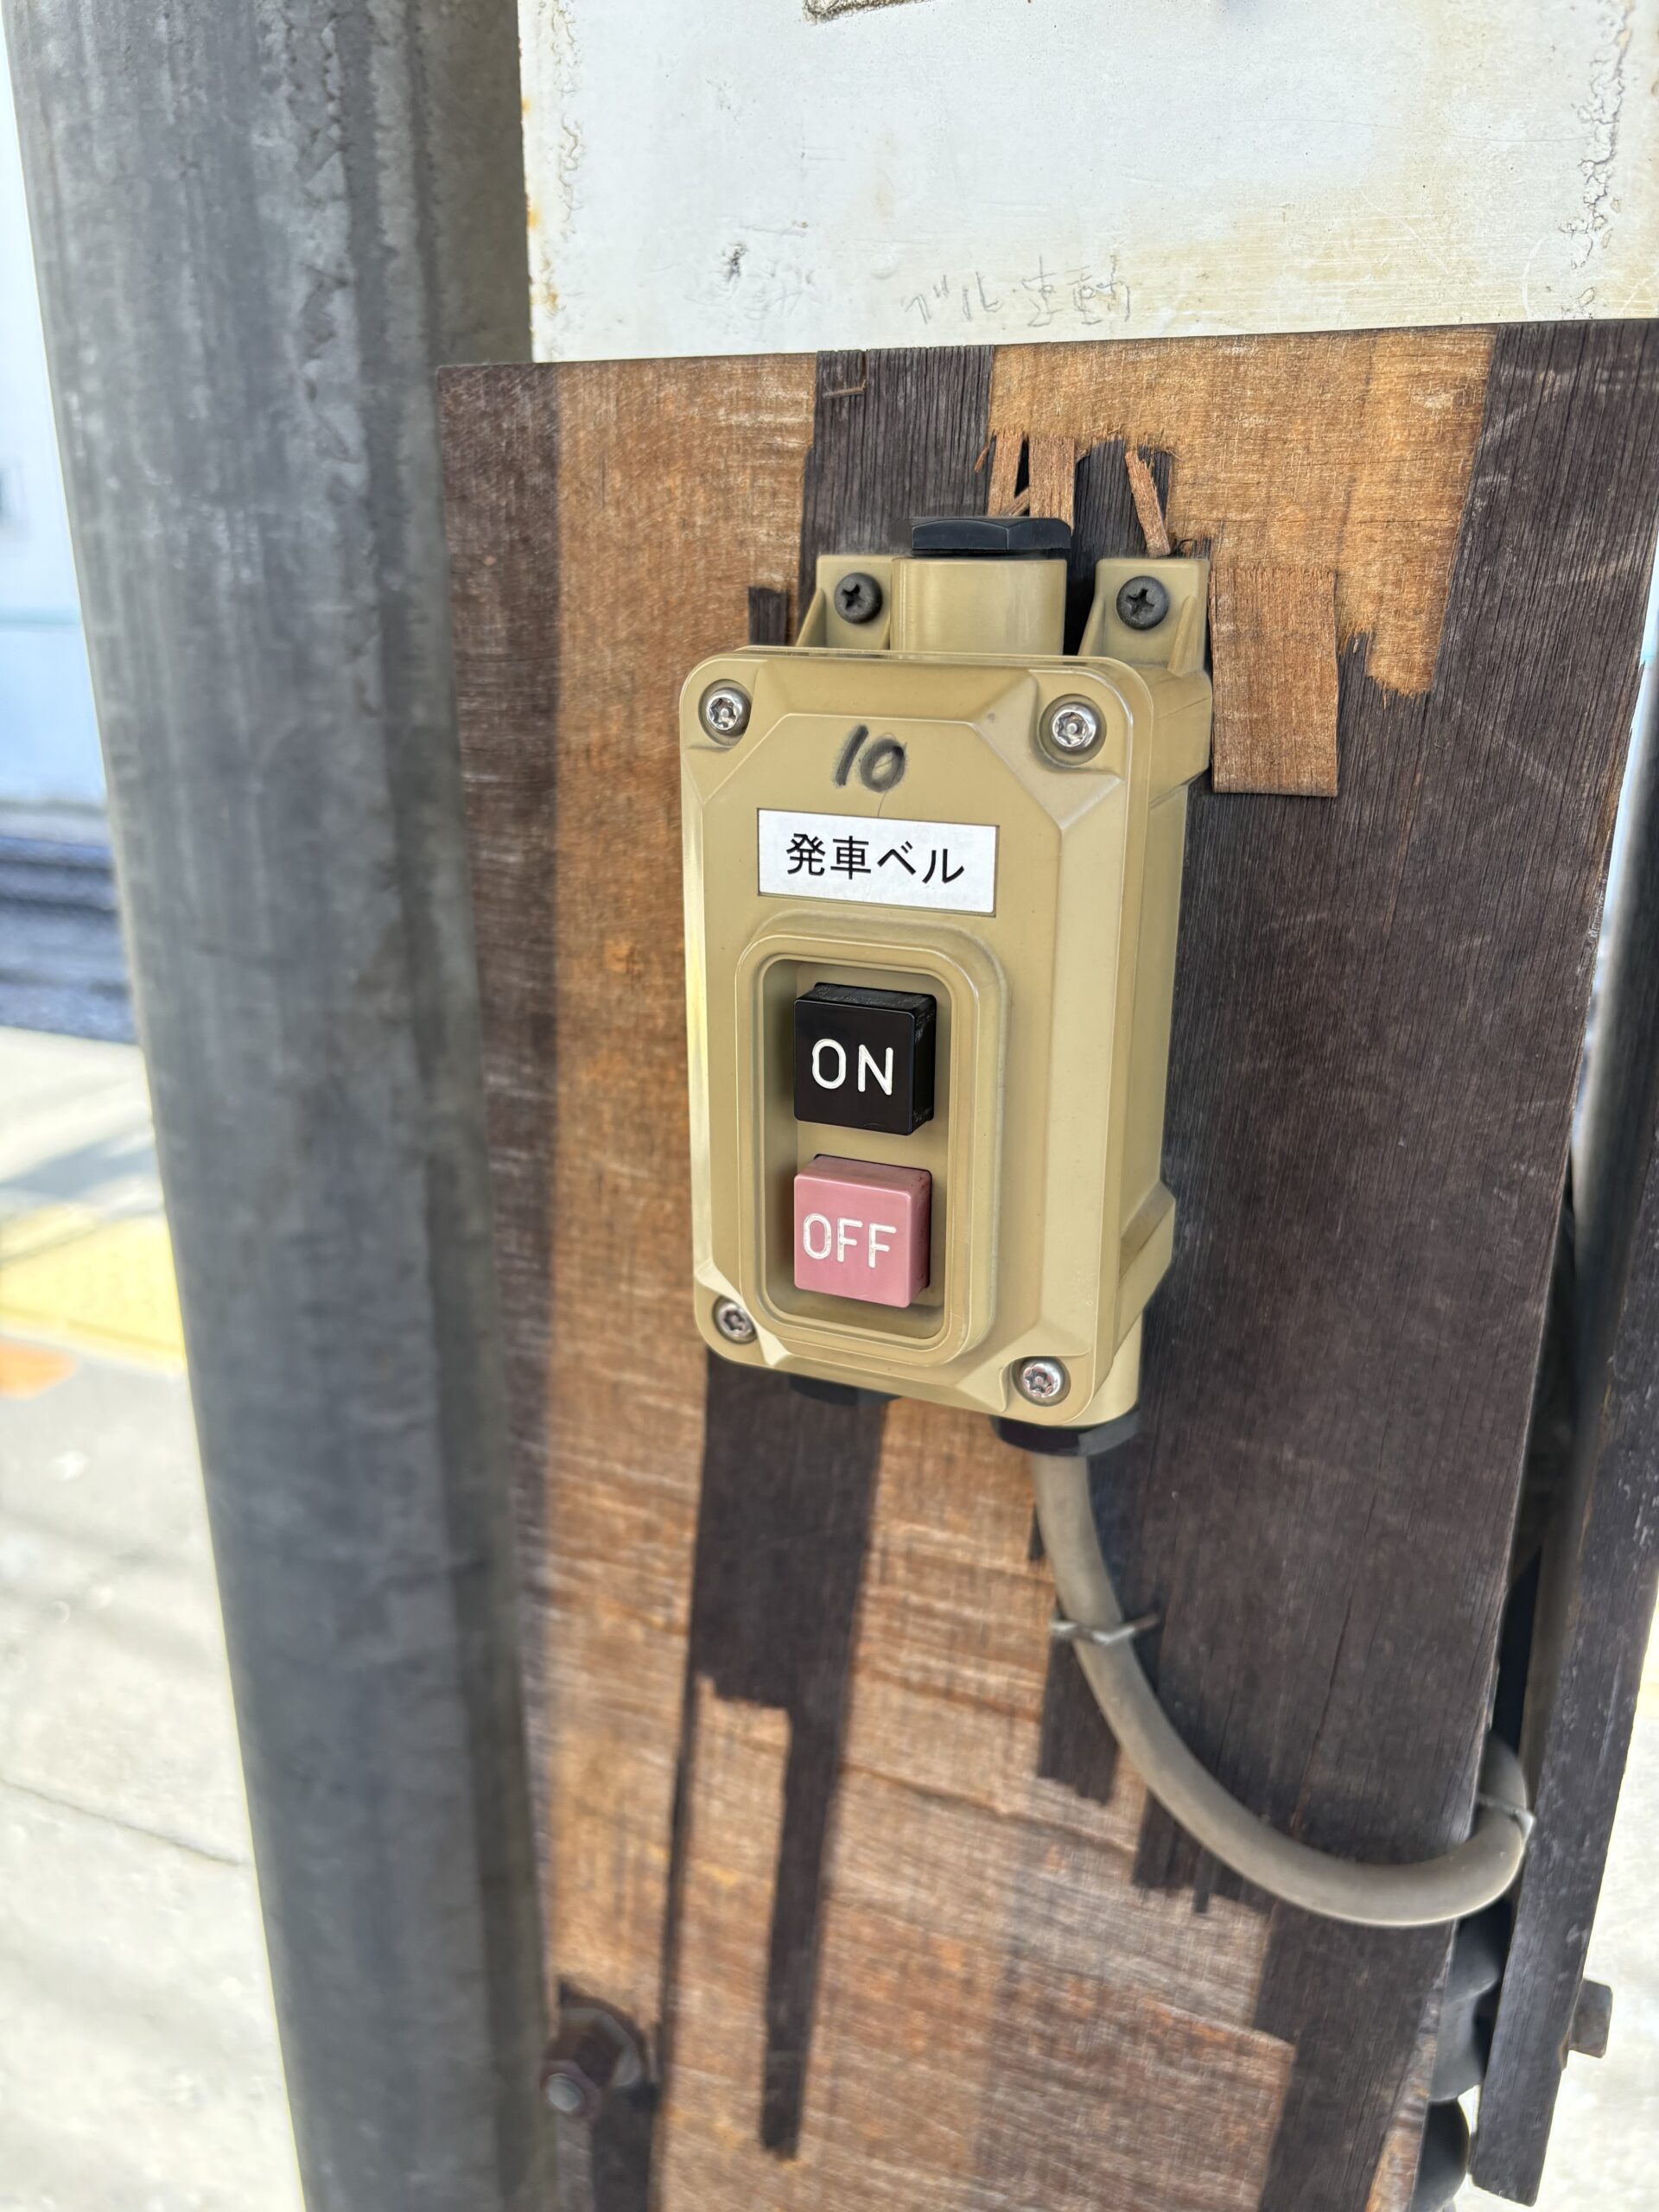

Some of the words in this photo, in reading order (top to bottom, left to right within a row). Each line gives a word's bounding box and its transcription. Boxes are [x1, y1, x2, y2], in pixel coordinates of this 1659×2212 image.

[833, 724, 906, 792] 10
[786, 833, 964, 884] 発車ベル
[811, 1038, 893, 1096] ON
[803, 1213, 897, 1268] OFF
